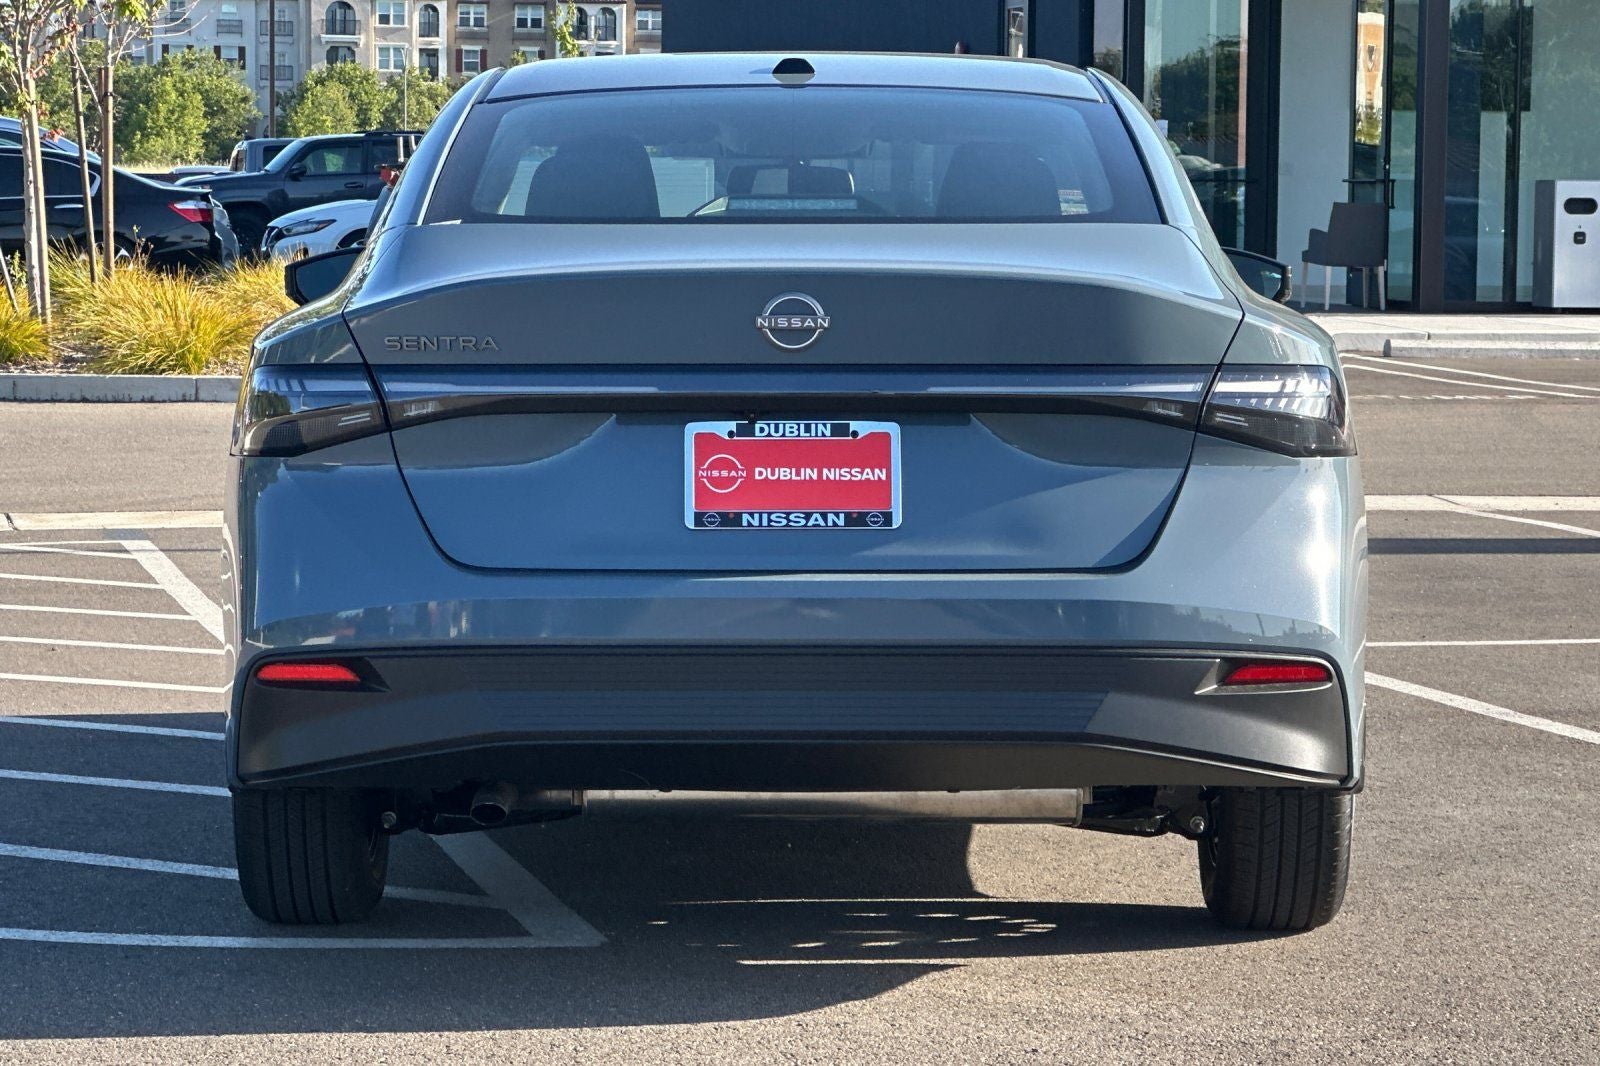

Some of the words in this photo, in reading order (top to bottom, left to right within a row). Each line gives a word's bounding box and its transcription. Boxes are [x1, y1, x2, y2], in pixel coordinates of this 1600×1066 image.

[757, 318, 829, 328] NISSAN
[384, 336, 499, 351] SENTRA
[754, 423, 831, 437] DUBLIN
[698, 470, 747, 478] NISSAN
[754, 467, 818, 481] DUBLIN
[822, 467, 887, 481] NISSAN
[741, 512, 845, 527] NISSAN
